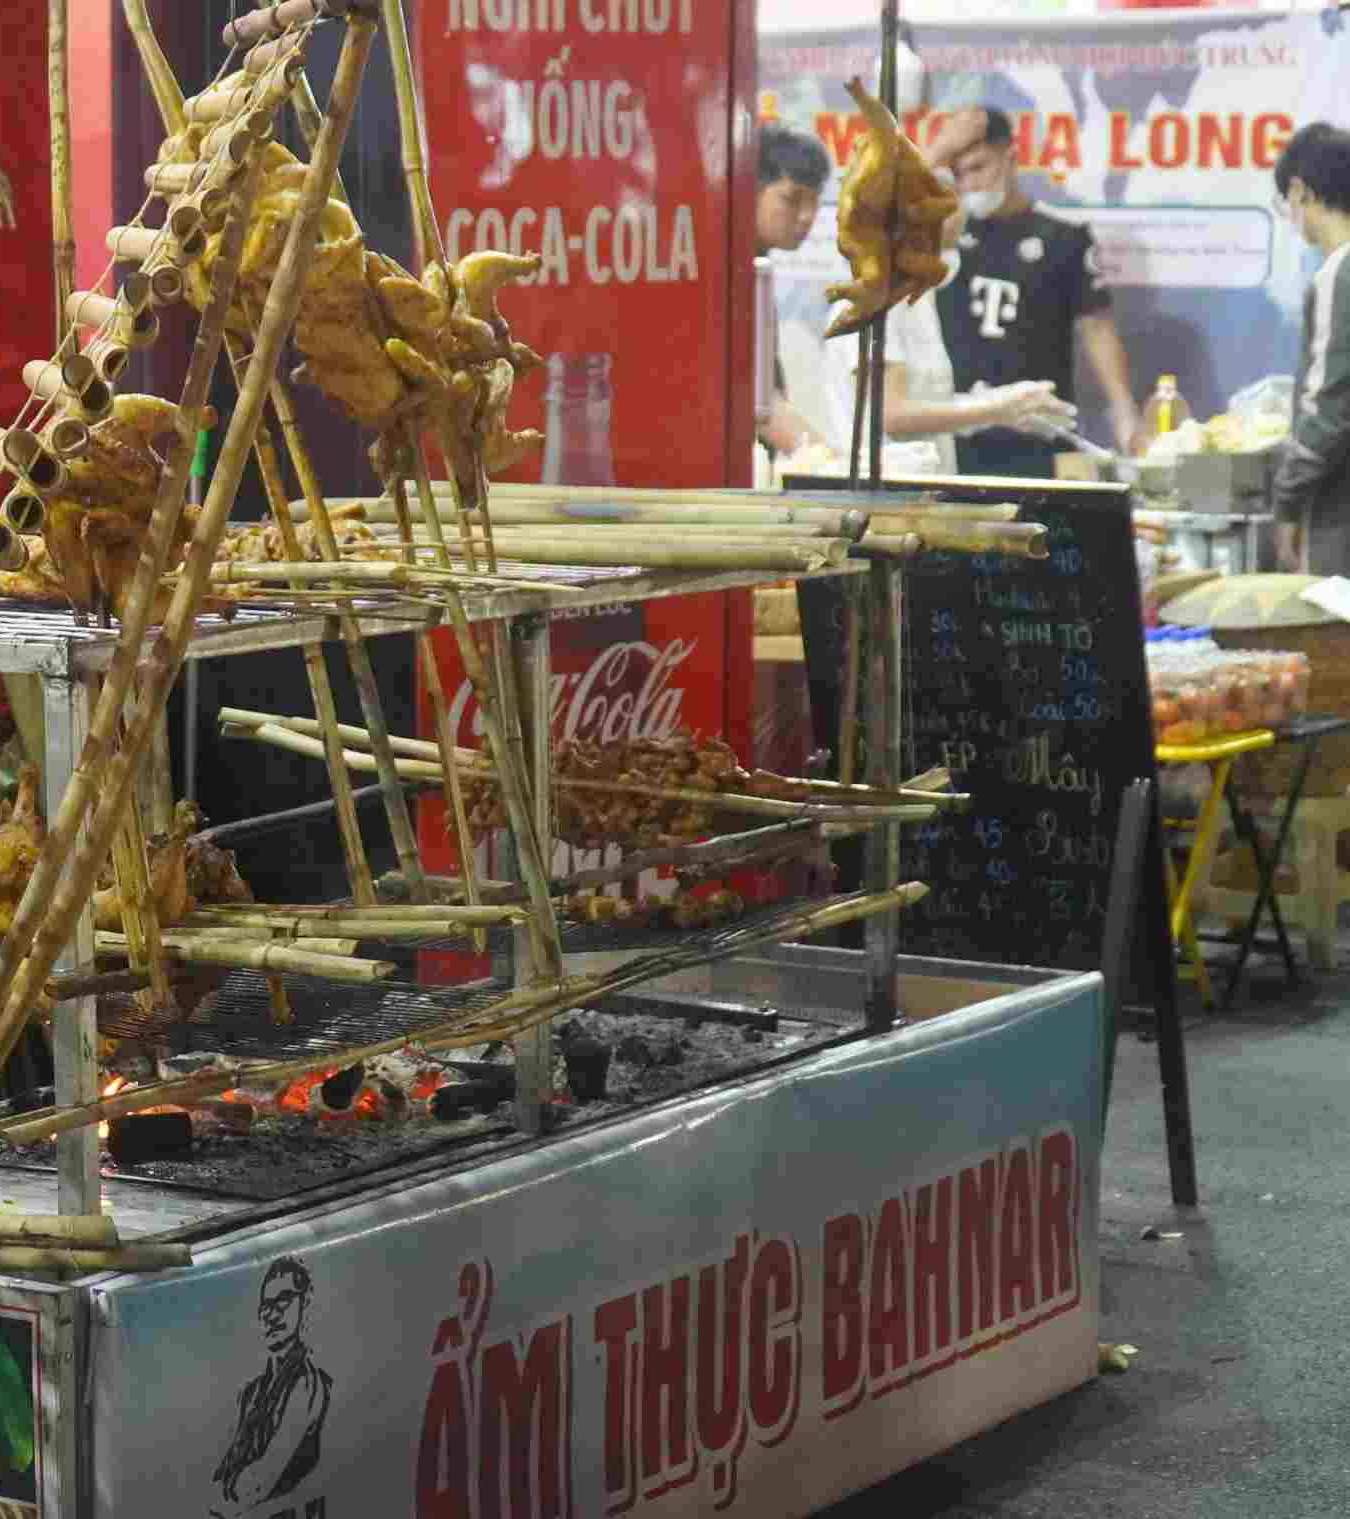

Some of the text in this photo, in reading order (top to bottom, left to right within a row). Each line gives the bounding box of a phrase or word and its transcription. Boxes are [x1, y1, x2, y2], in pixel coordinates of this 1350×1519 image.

[1108, 112, 1290, 170] LONG
[446, 204, 699, 287] COCA-COLA
[970, 275, 1020, 337] T
[414, 1130, 1082, 1519] ẨM THỰC BAHNAR
